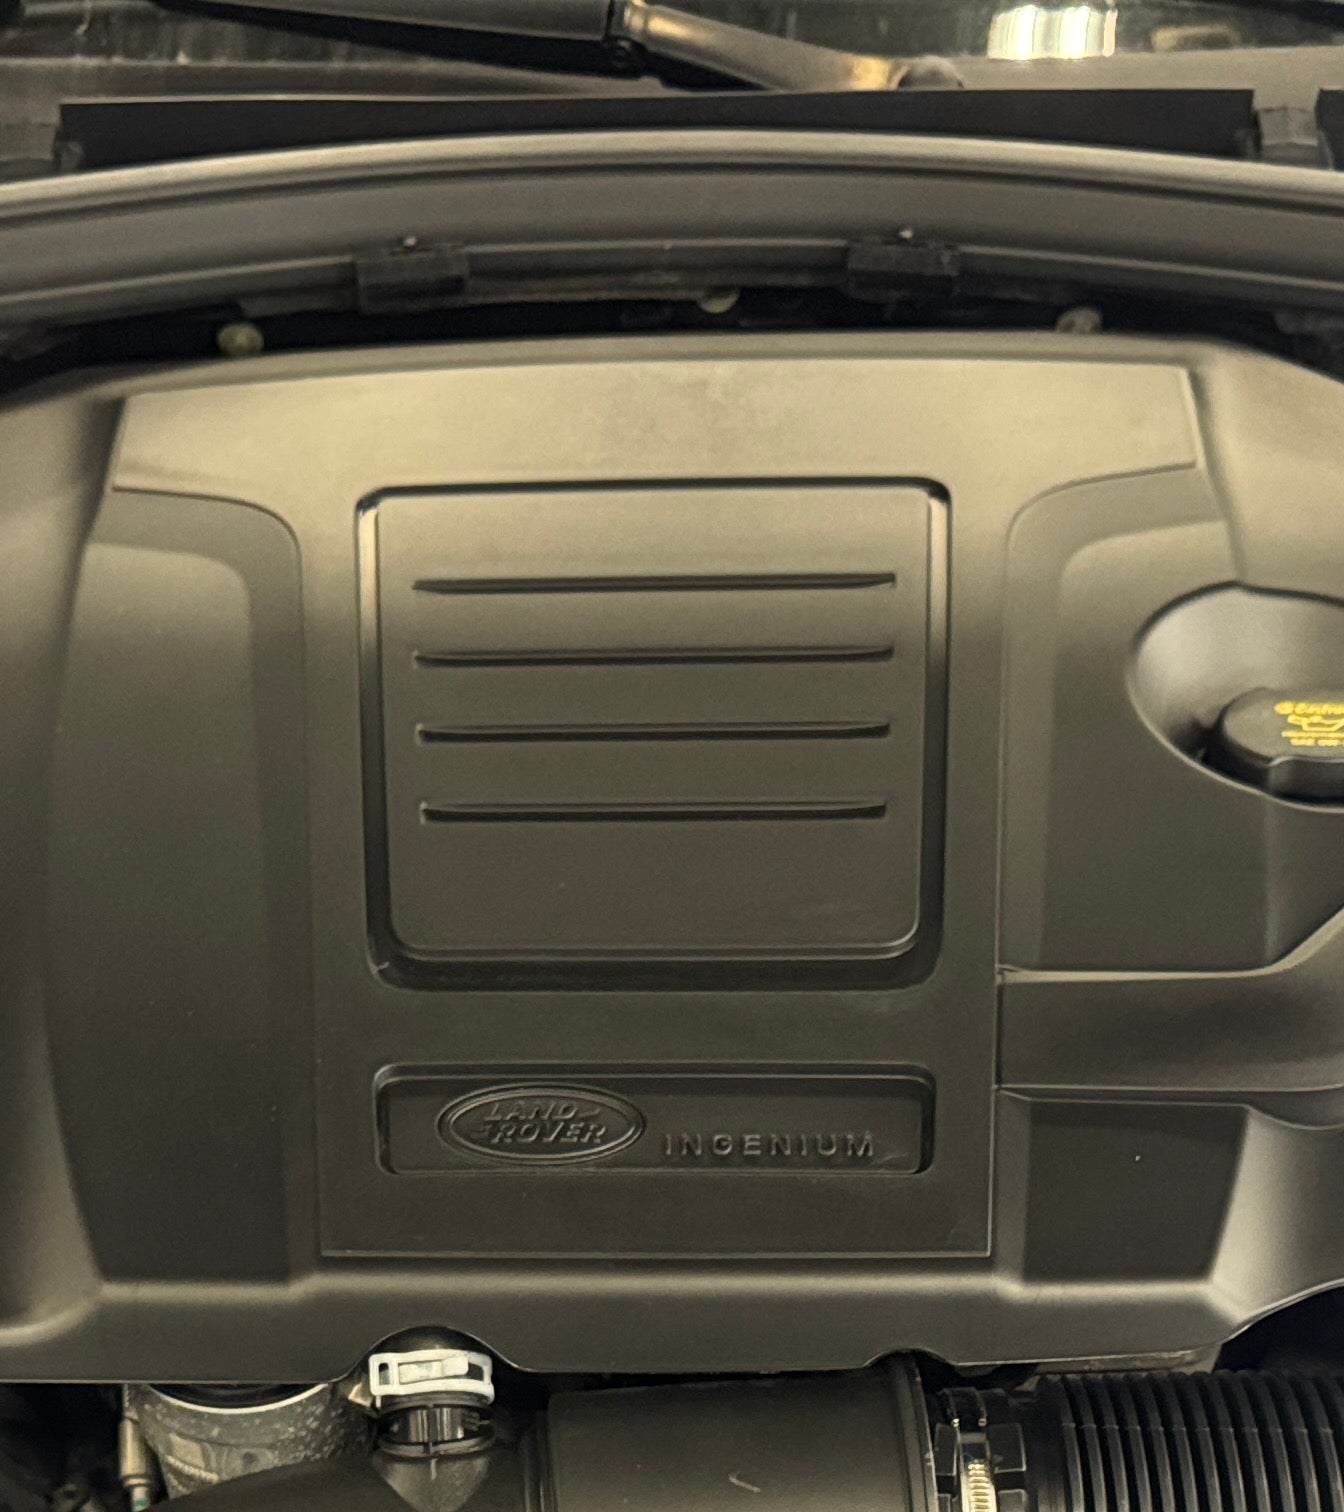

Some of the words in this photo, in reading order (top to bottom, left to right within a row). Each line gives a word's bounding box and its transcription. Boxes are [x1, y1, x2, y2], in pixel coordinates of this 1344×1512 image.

[483, 1101, 579, 1121] LAND
[490, 1122, 606, 1145] ROVER
[664, 1131, 876, 1159] INGENIUM
